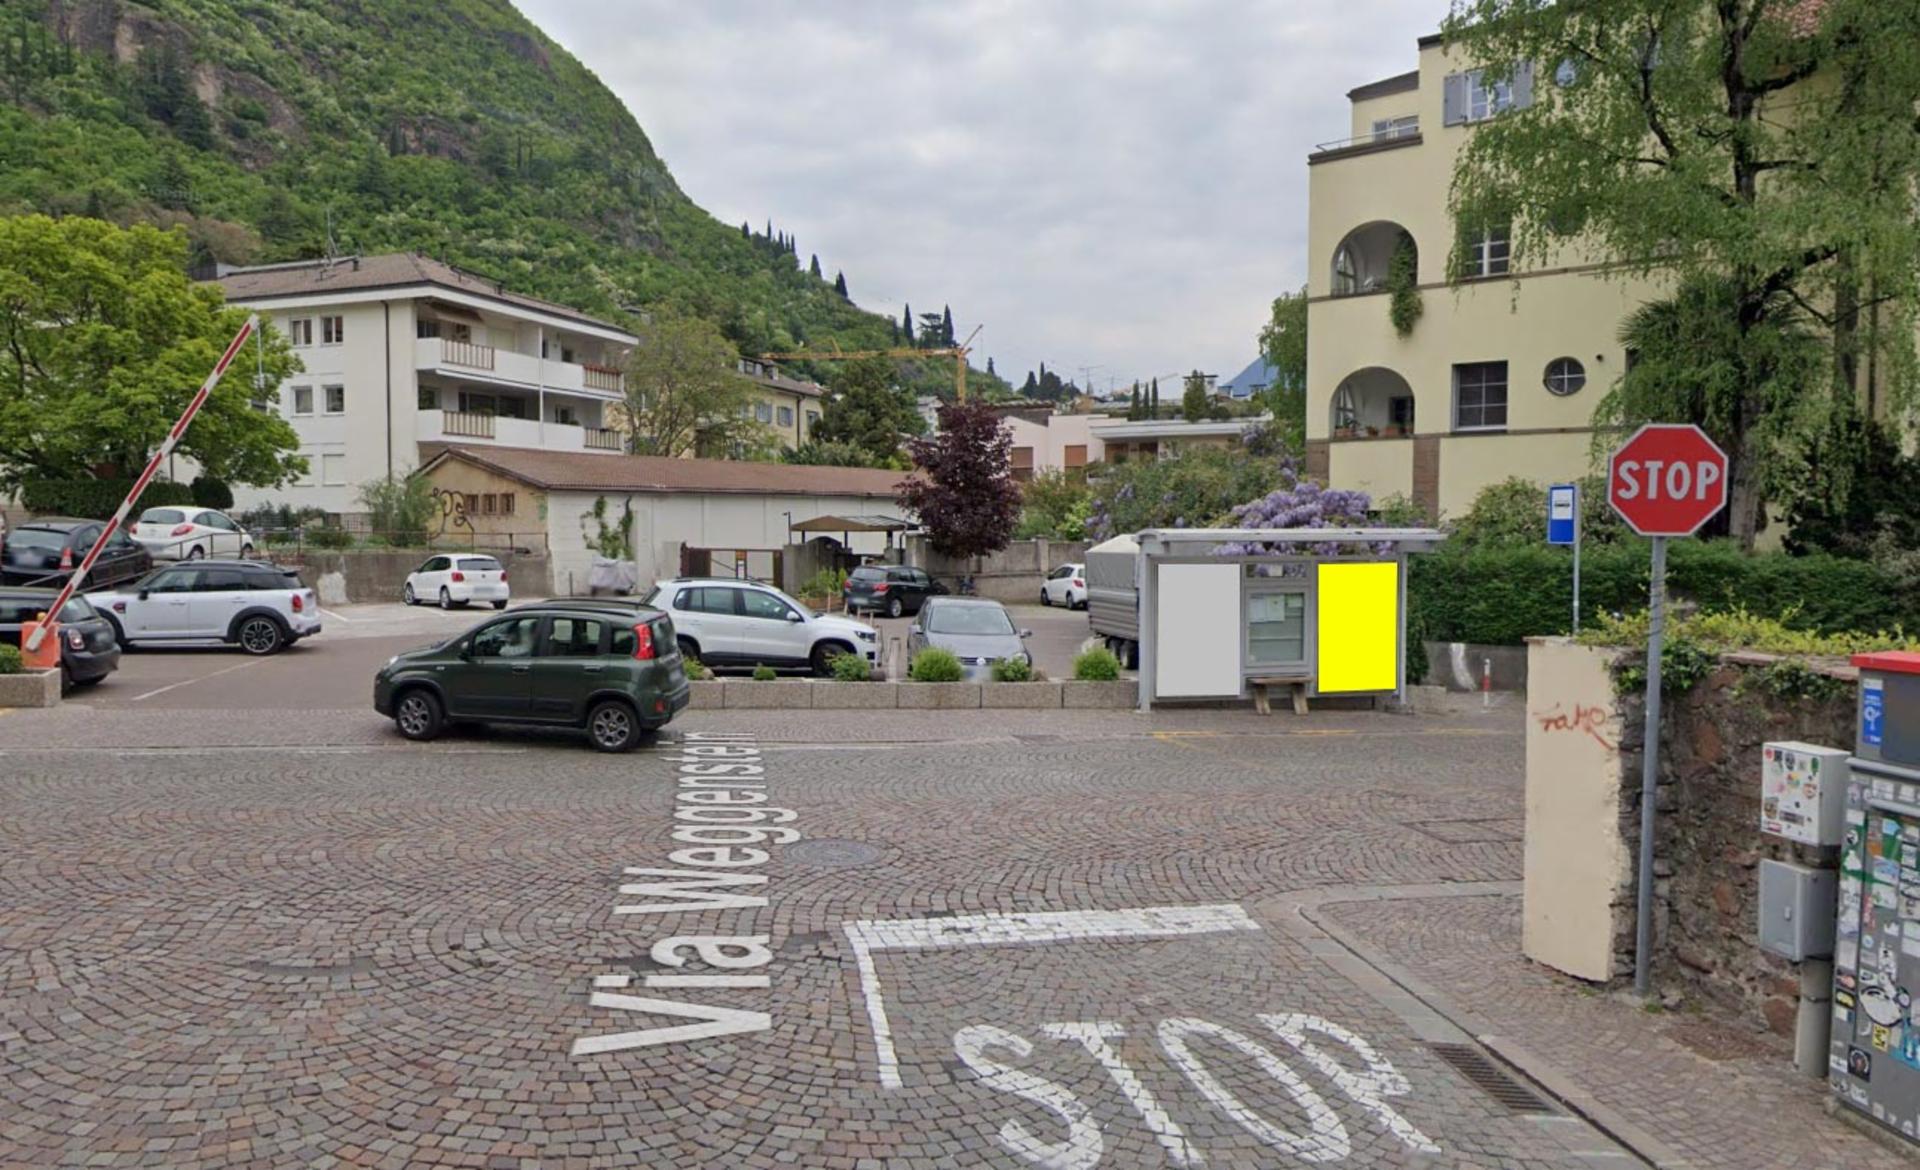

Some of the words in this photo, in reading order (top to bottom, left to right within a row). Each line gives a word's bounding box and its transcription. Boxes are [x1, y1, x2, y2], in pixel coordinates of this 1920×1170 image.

[1617, 460, 1720, 500] STOP
[612, 731, 801, 915] Weggenstein
[570, 933, 774, 1056] Via
[953, 1012, 1443, 1170] STOP
